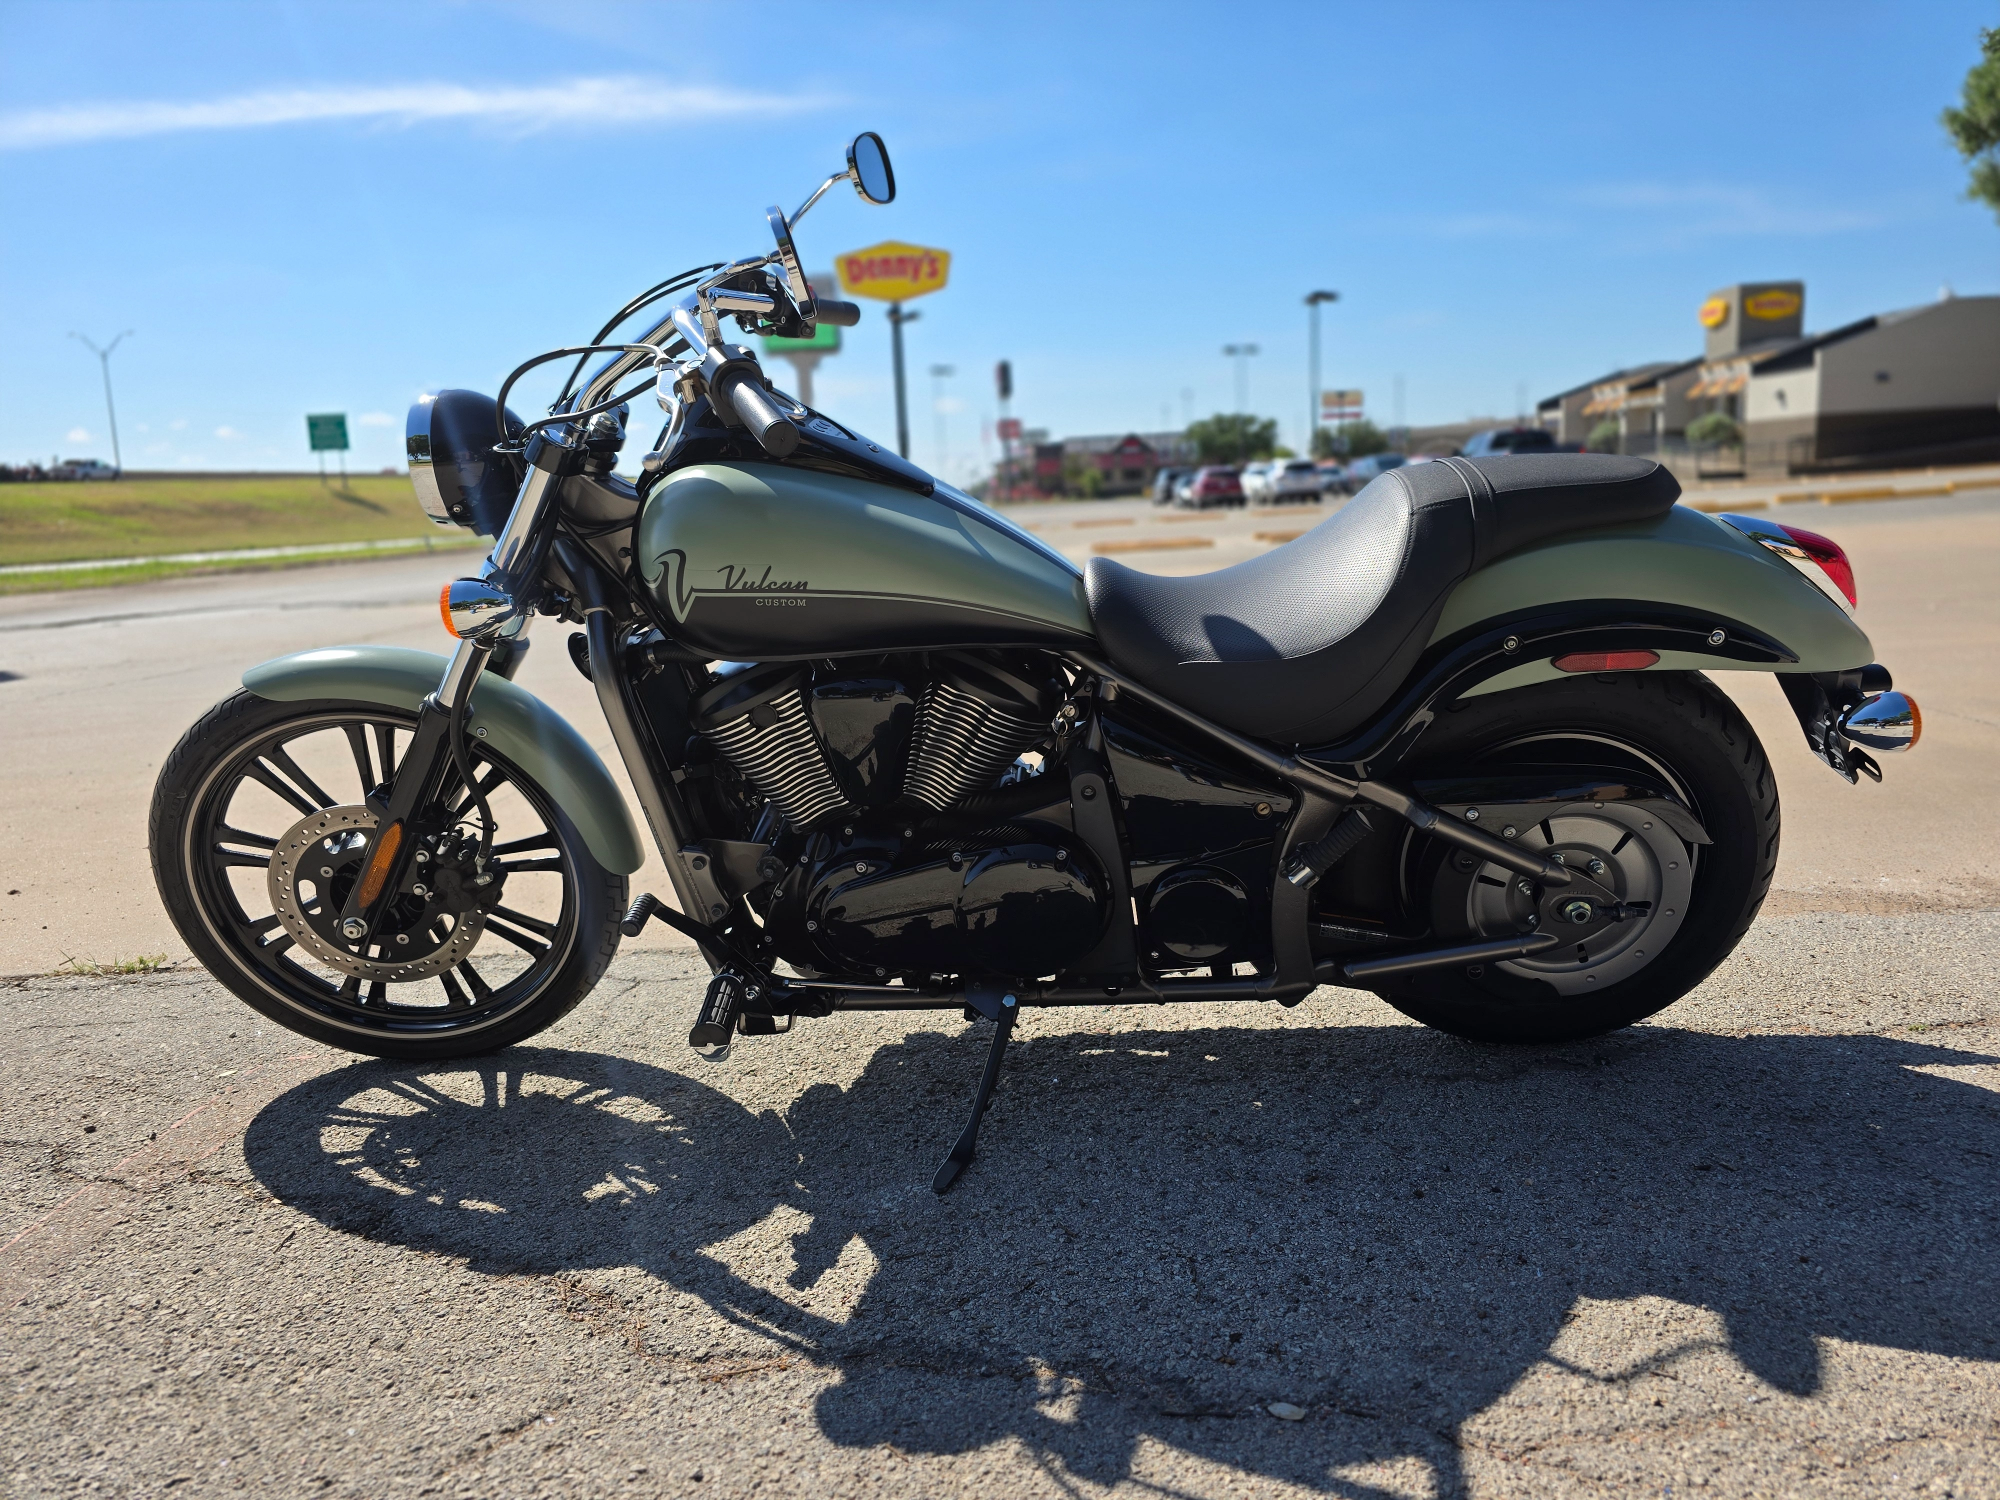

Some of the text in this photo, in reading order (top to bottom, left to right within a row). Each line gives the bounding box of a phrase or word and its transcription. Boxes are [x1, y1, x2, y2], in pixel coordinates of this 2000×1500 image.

[845, 250, 940, 284] Denny's
[717, 564, 809, 590] Vulcan
[755, 598, 807, 607] CUSTOM
